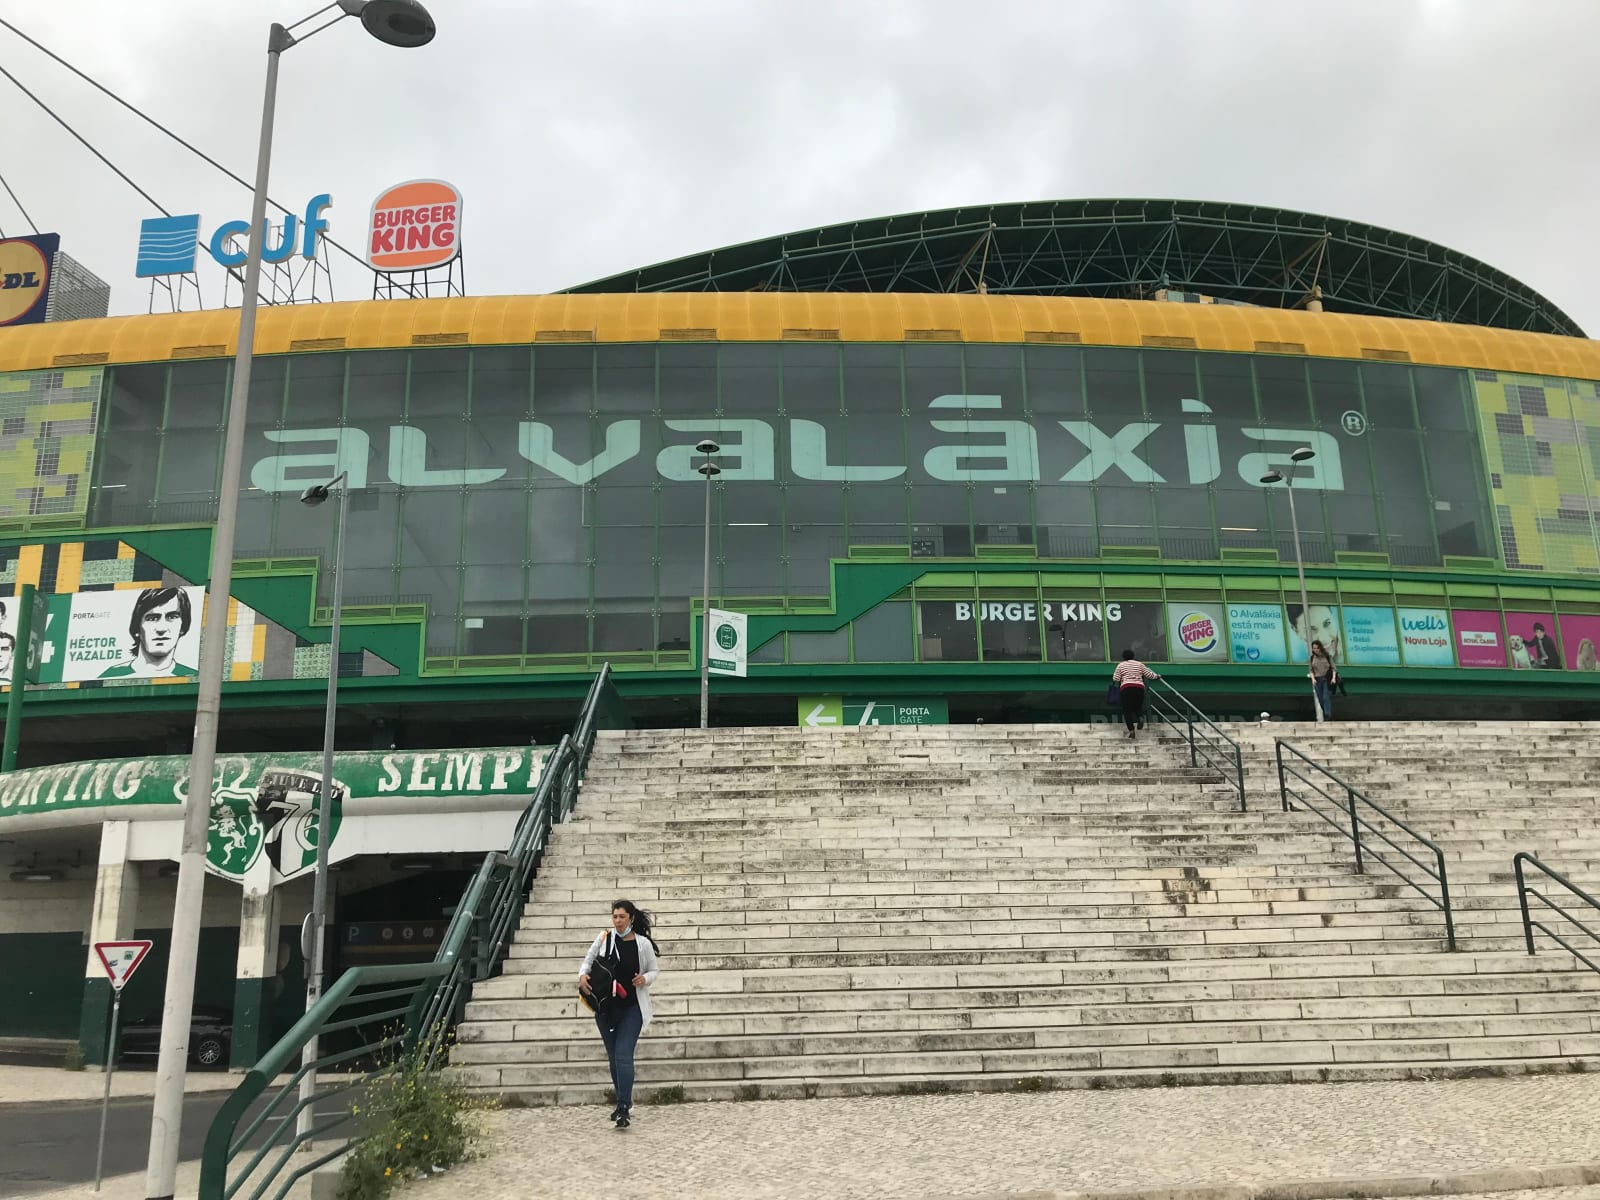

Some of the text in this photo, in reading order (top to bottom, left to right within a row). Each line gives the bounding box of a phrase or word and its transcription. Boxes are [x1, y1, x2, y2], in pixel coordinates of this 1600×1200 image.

[374, 205, 456, 229] BURGER
[210, 193, 333, 268] cuf
[371, 222, 455, 254] KING
[0, 271, 40, 290] DL
[955, 602, 1122, 622] BURGER KING
[1230, 609, 1281, 619] O Alvaláxia
[1182, 619, 1212, 634] BURGER
[1231, 620, 1276, 629] está mais
[69, 635, 117, 649] HÉCTOR
[1183, 627, 1214, 645] KING
[1232, 631, 1261, 640] Well's
[1404, 636, 1448, 647] Nova Loja
[69, 649, 122, 662] YAZALDE
[900, 707, 930, 716] PORTA
[899, 716, 923, 725] GATE
[0, 761, 145, 809] ORTING
